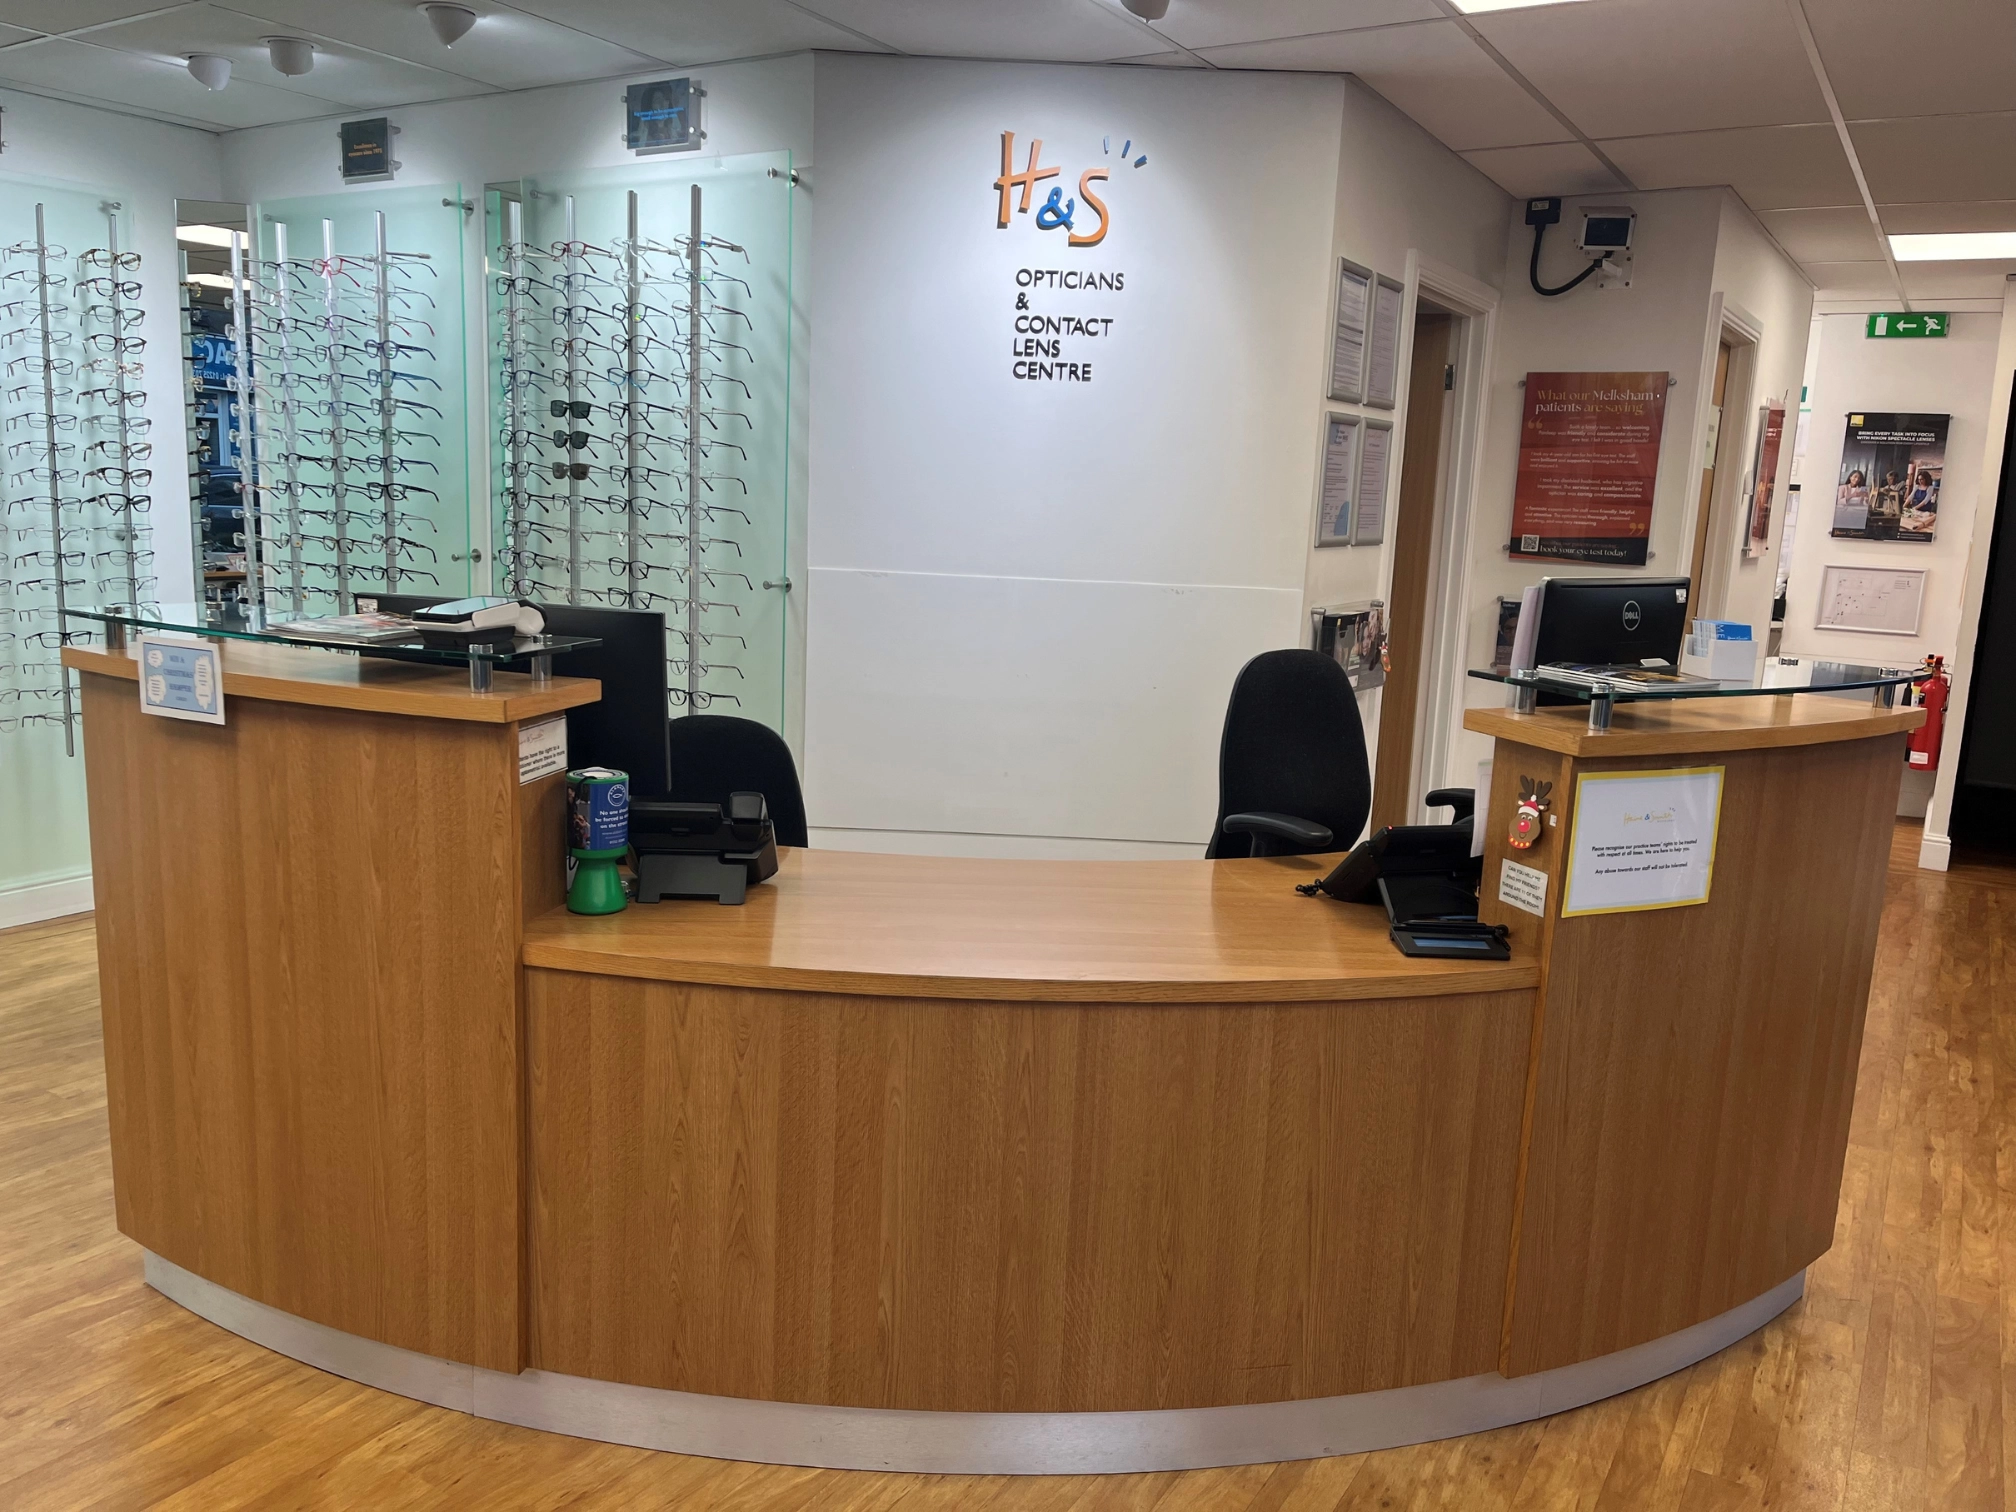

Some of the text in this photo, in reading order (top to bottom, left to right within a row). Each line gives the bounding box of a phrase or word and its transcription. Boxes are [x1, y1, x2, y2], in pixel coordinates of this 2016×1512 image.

[996, 130, 1110, 246] H&S
[1016, 268, 1124, 291] OPTICIANS
[1015, 292, 1030, 311] &
[1014, 315, 1114, 337] CONTACT
[1013, 338, 1060, 358] LENS
[1012, 360, 1092, 382] CENTRE
[1538, 389, 1654, 400] What our Melksham
[1535, 402, 1582, 414] patients
[1584, 404, 1603, 412] are
[1502, 881, 1513, 889] THERE
[1503, 891, 1519, 901] AROUND
